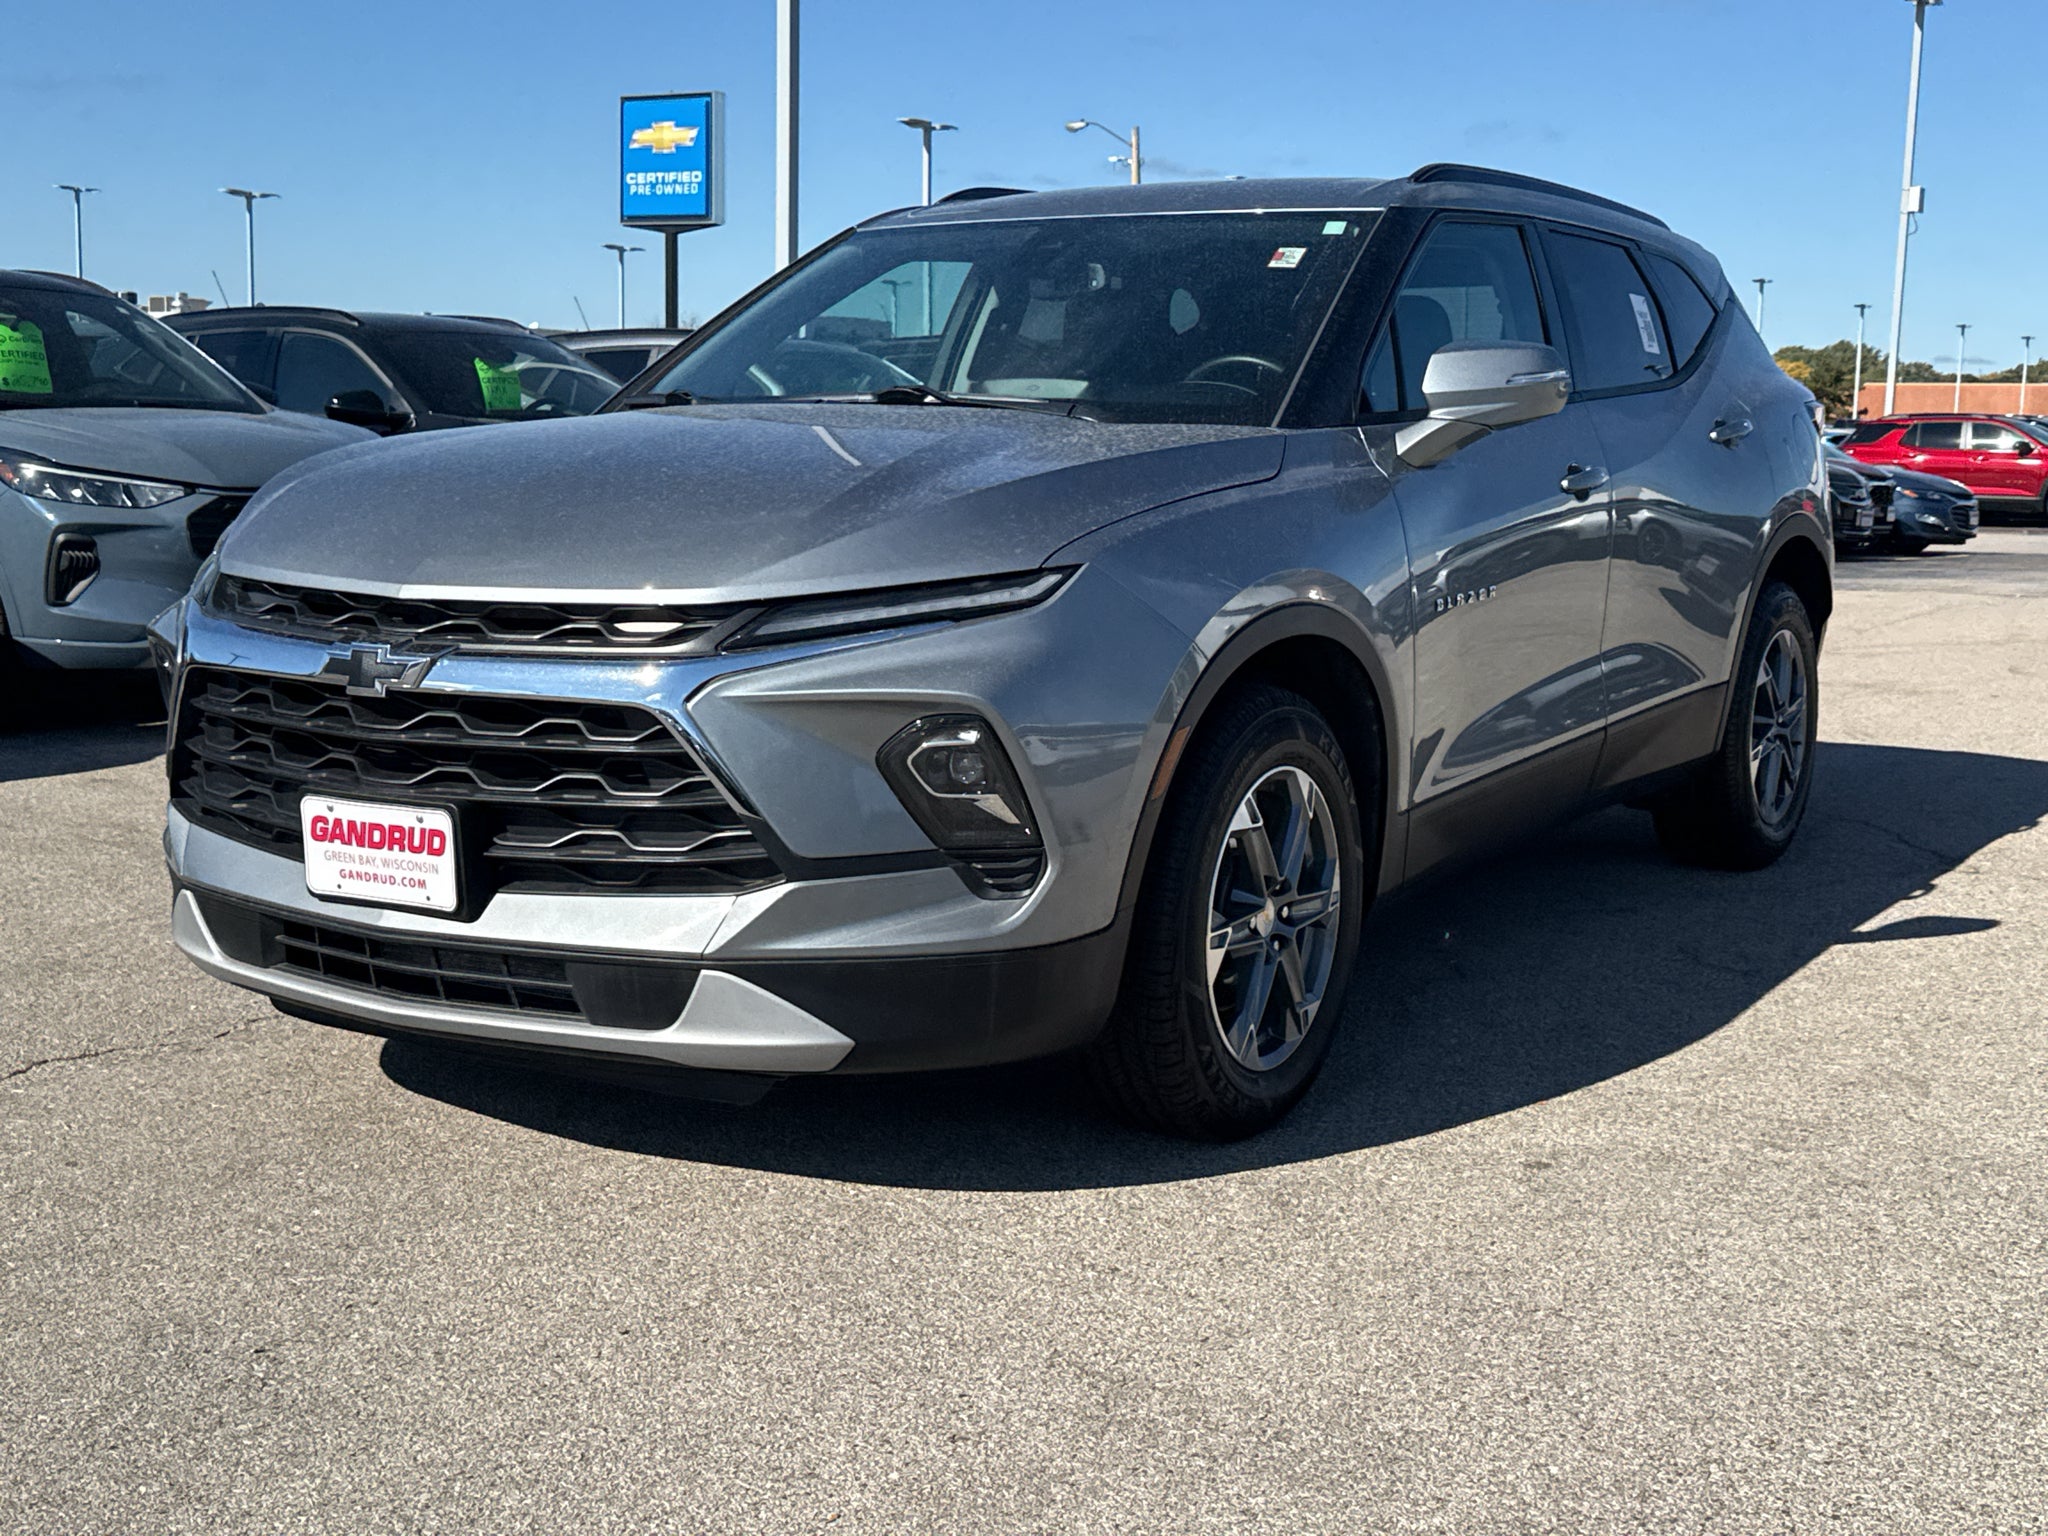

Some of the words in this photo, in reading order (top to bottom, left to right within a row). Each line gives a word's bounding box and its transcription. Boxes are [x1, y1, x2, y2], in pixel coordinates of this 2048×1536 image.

[626, 171, 702, 184] CERTIFIED
[629, 183, 699, 196] PRE-OWNED
[0, 349, 46, 361] ERTIFIED
[1435, 585, 1497, 612] BLAZER
[310, 814, 447, 858] GANDRUD
[323, 849, 356, 865] GREEN
[358, 854, 380, 869] BAY,
[380, 858, 439, 875] WISCONSIN
[339, 868, 427, 890] GANDRUD.COM
